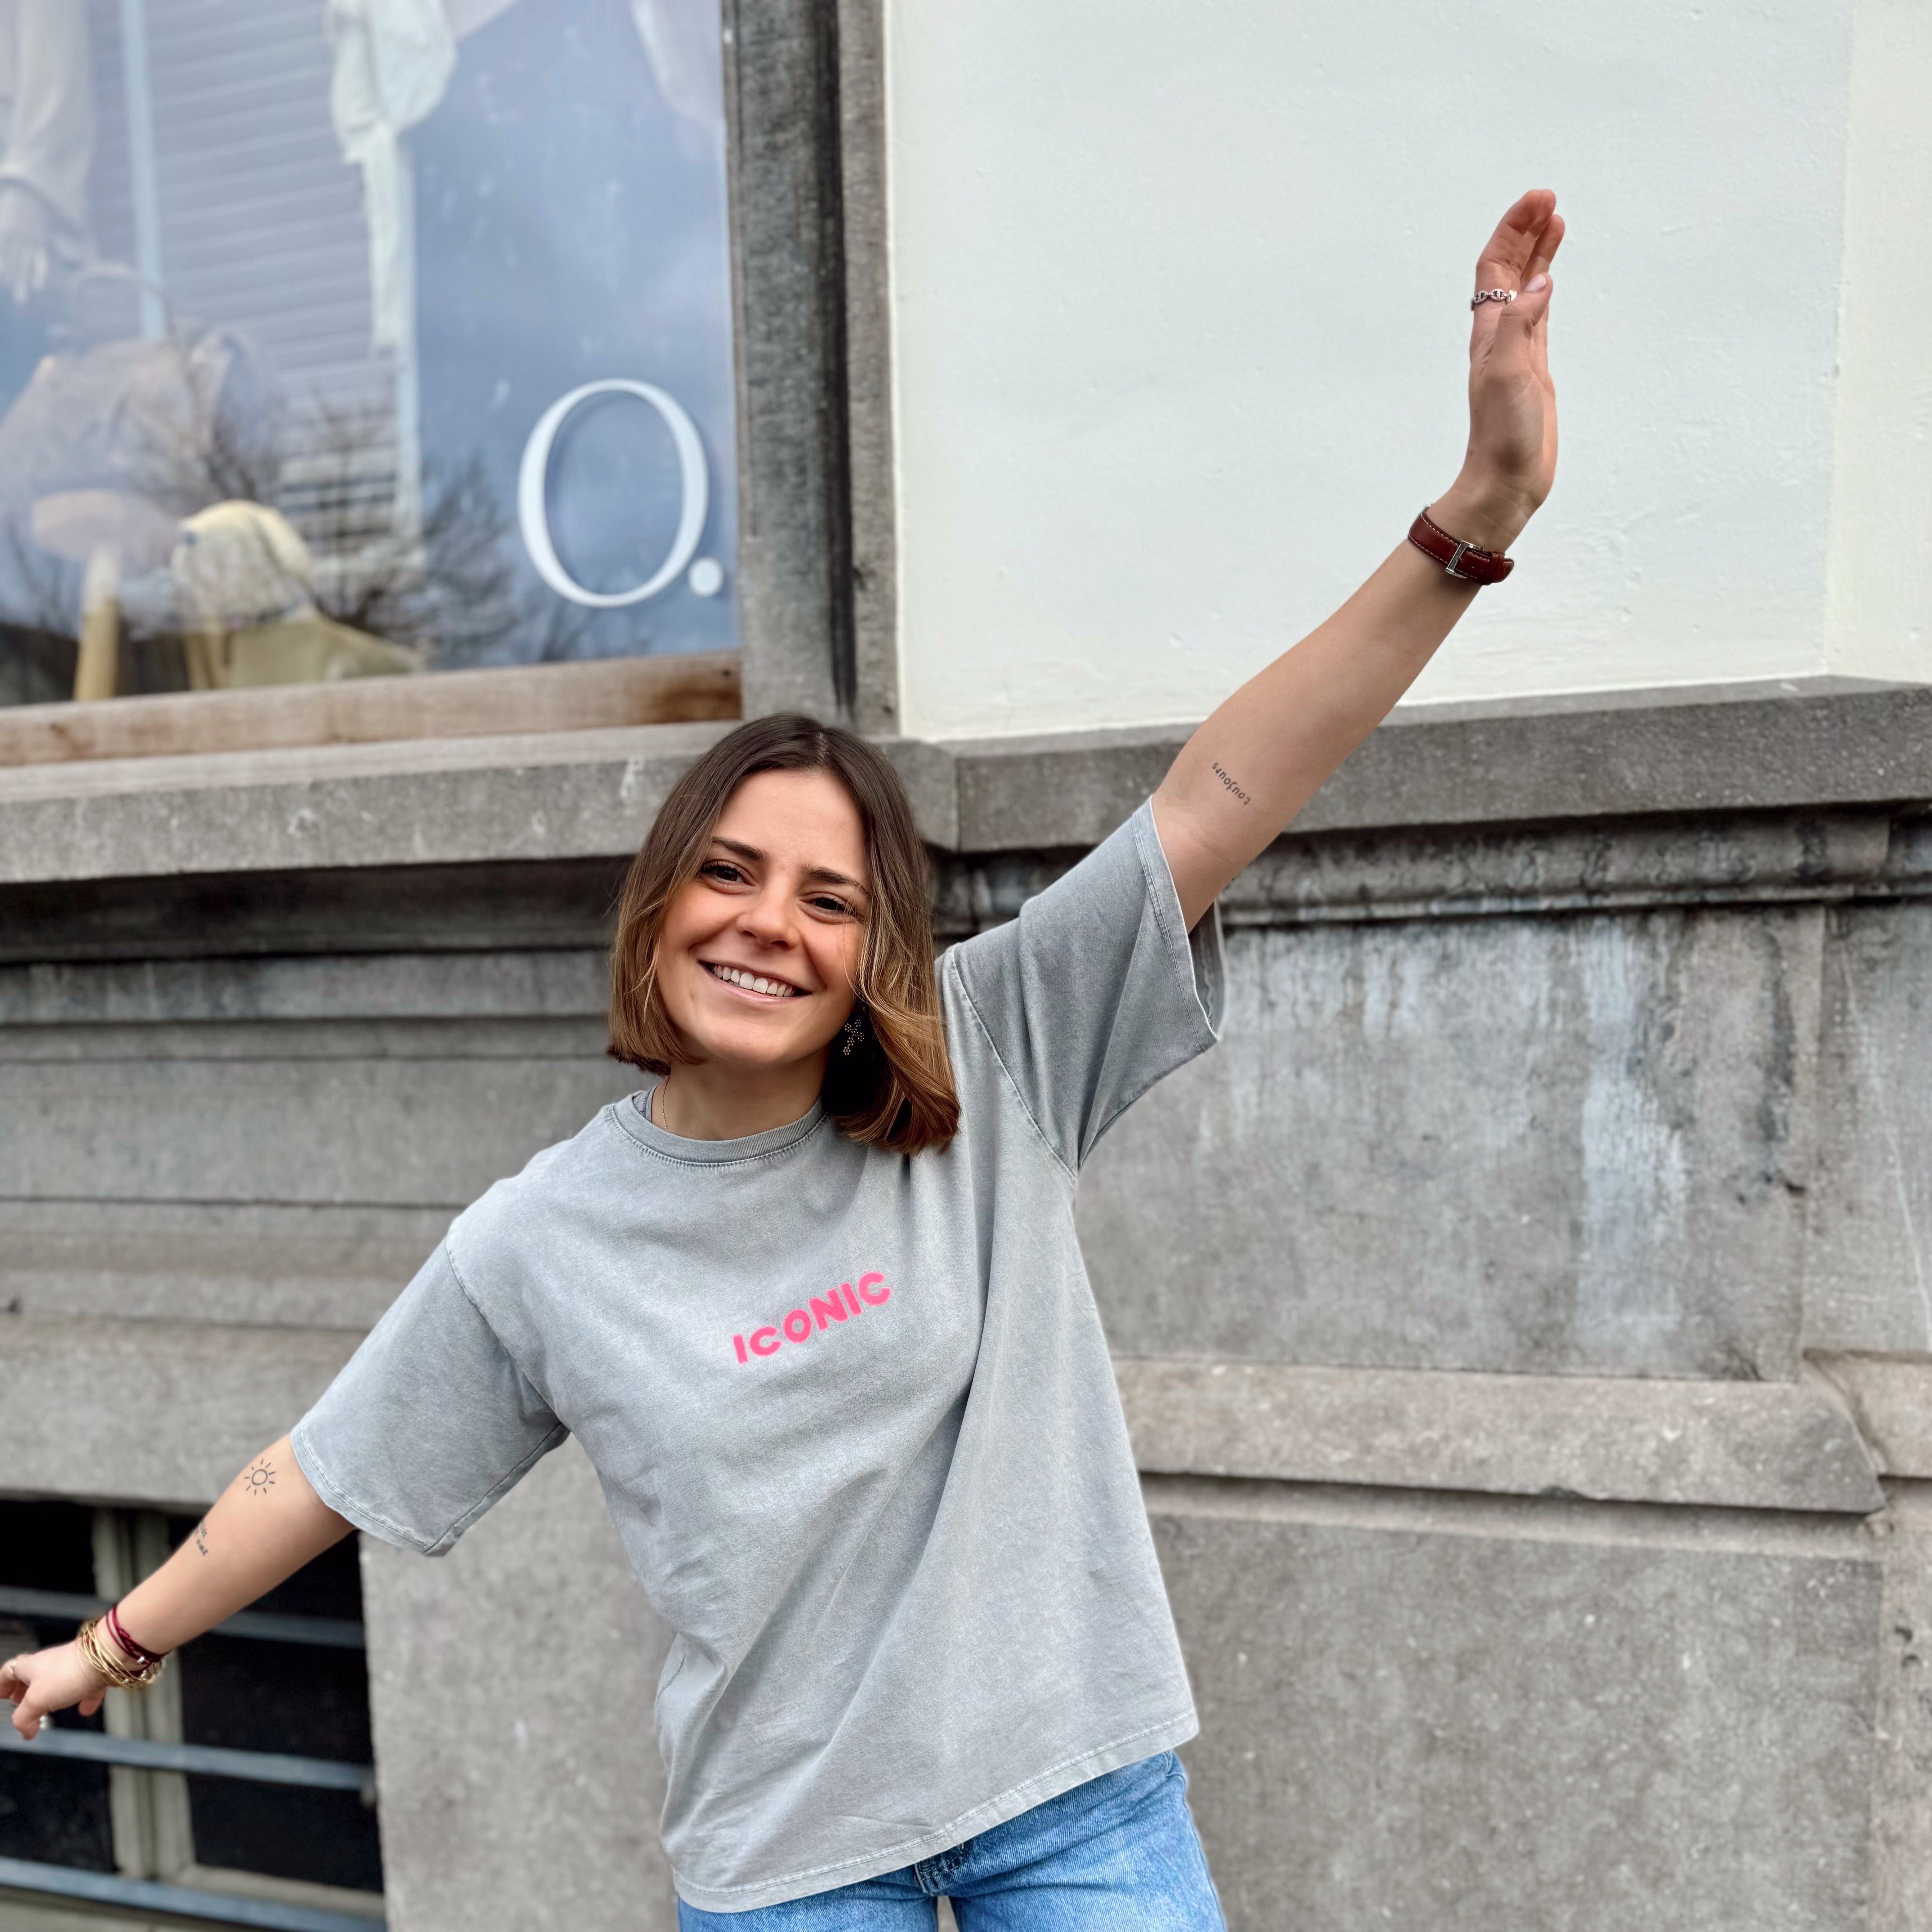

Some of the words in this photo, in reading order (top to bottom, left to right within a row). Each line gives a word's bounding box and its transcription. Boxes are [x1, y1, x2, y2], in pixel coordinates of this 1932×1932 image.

[518, 378, 722, 607] O.
[1212, 762, 1251, 805] toujours
[732, 1271, 892, 1365] ICONIC
